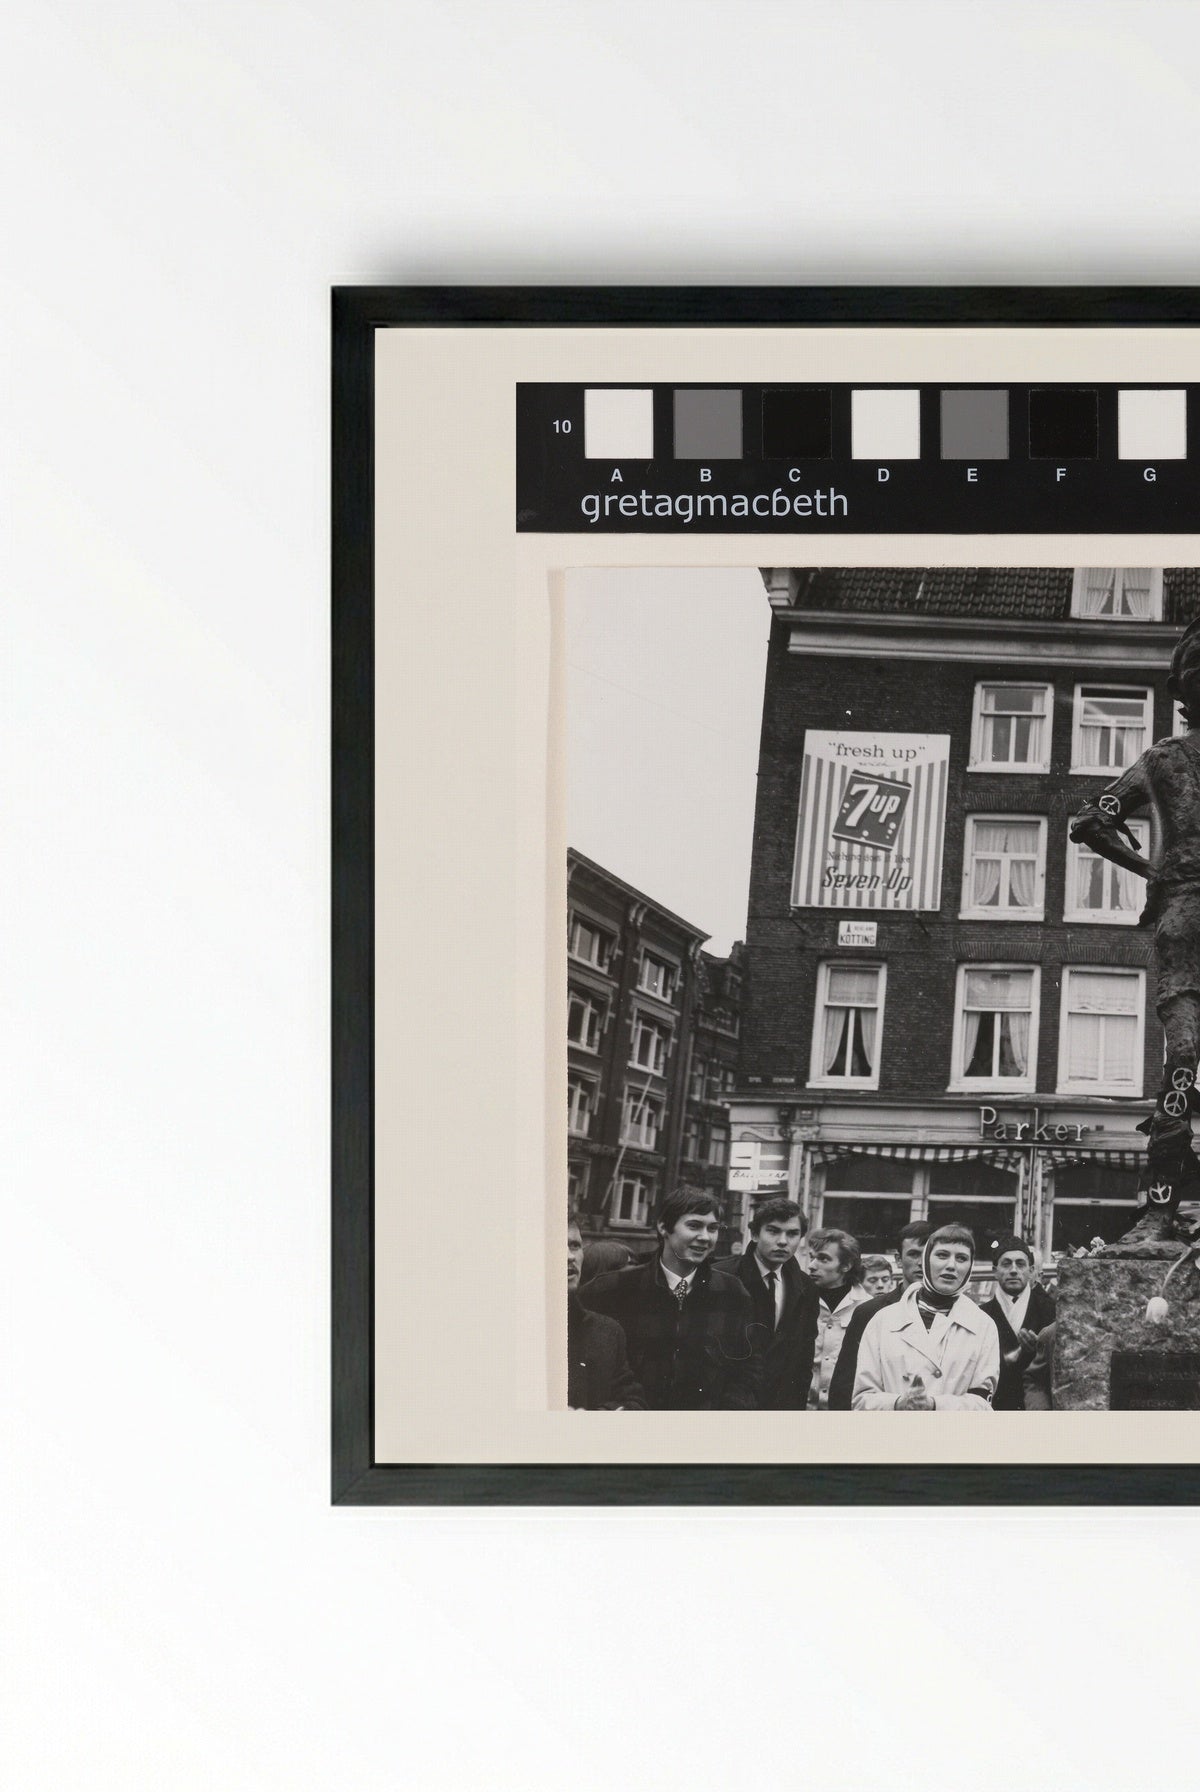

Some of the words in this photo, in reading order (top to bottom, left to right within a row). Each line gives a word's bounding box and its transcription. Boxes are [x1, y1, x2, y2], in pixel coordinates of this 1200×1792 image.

[552, 419, 572, 434] 10
[611, 469, 623, 482] A
[700, 468, 712, 482] B
[788, 468, 801, 482] C
[877, 468, 890, 482] D
[967, 468, 978, 482] E
[1056, 468, 1067, 482] F
[1143, 467, 1157, 482] G
[581, 487, 848, 524] gretagmacbeth
[979, 1106, 1089, 1141] Parker
